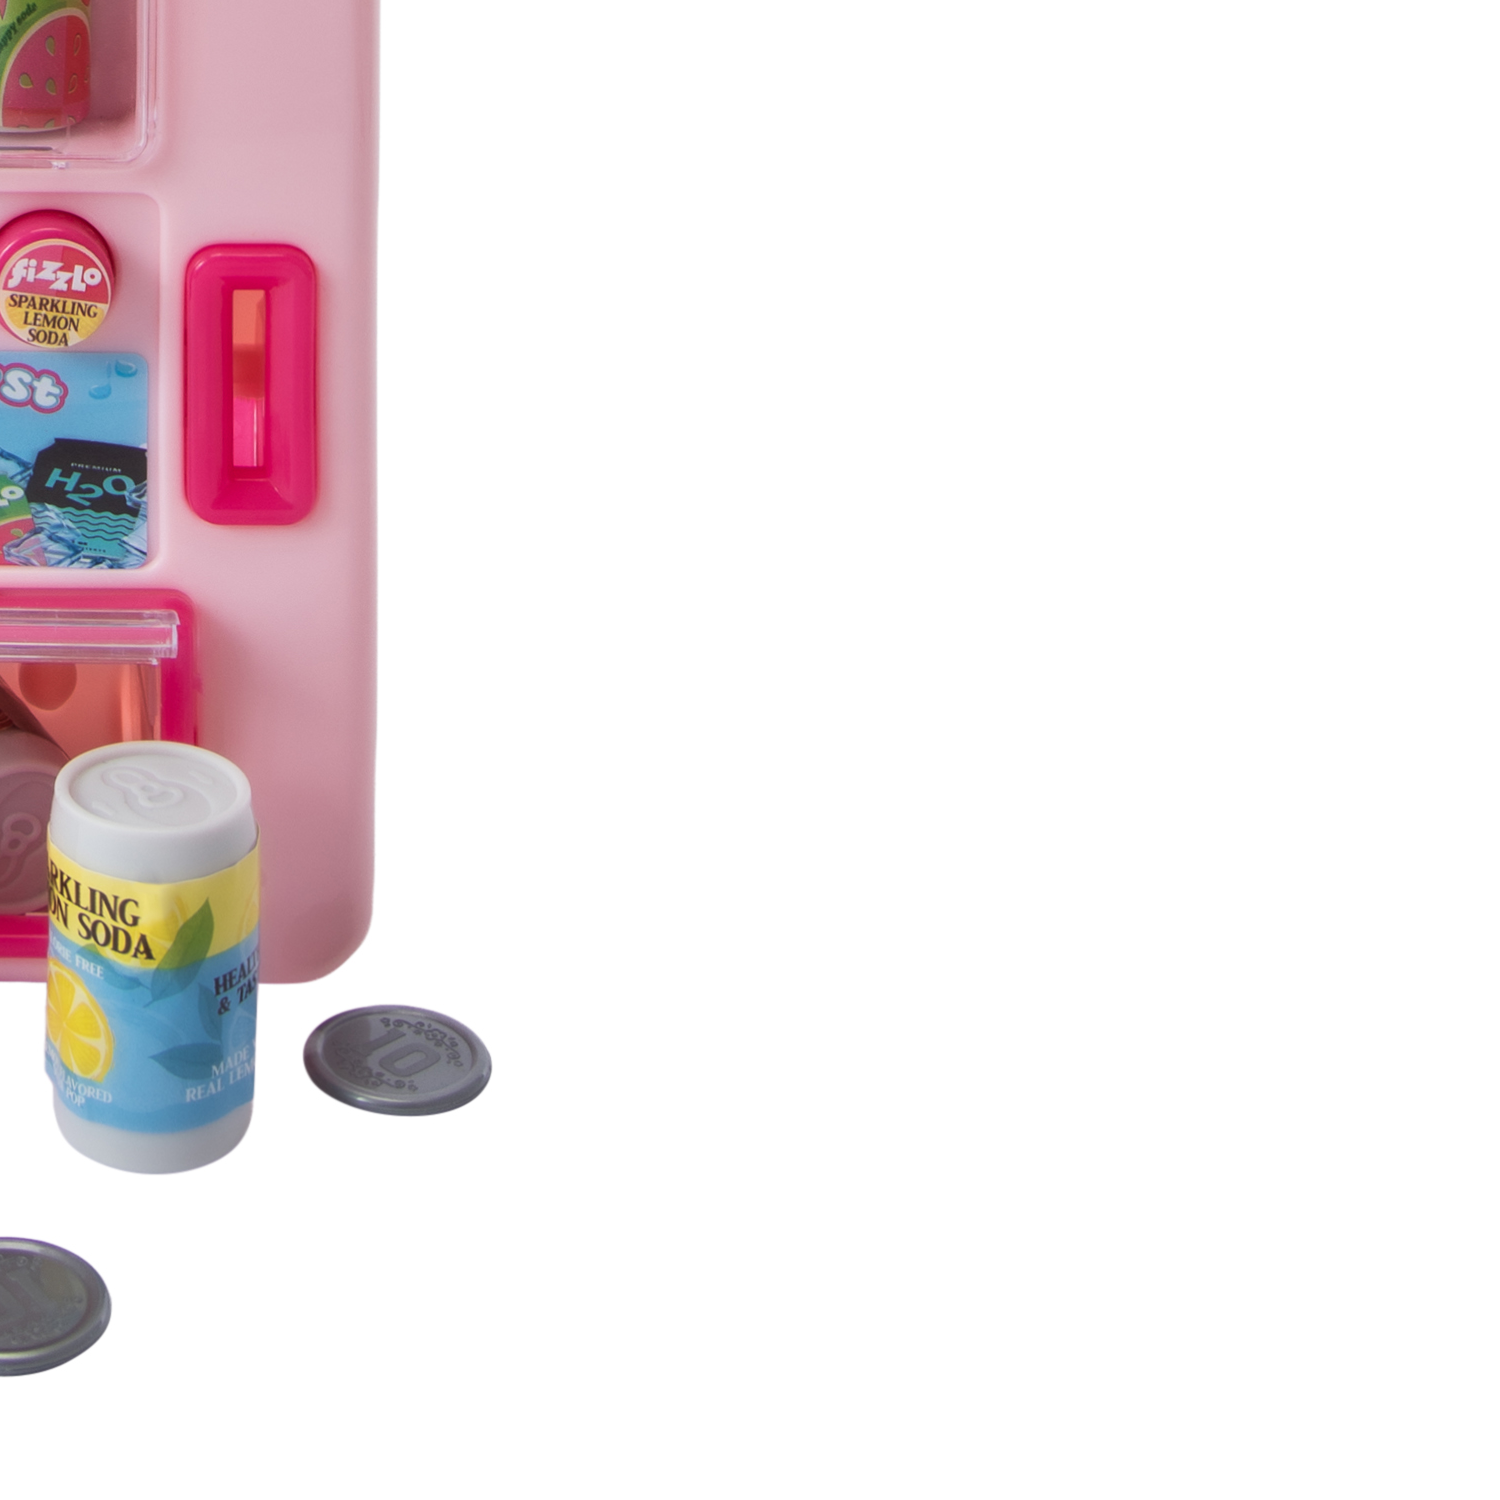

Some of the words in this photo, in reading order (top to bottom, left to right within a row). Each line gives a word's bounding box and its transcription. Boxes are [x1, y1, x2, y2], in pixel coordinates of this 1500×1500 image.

[16, 2, 38, 26] soda
[7, 257, 102, 292] fizzlo
[8, 293, 98, 318] SPARKLING
[23, 311, 80, 332] LEMON
[27, 328, 69, 347] SODA
[70, 462, 122, 473] PREMIUM
[49, 858, 141, 927] RKLING
[77, 912, 156, 961] SODA
[51, 936, 73, 963] ORIE
[75, 954, 104, 980] FREE
[214, 951, 259, 997] HEALT
[218, 996, 232, 1016] &
[211, 1044, 251, 1079] MADE
[351, 1027, 442, 1078] 10
[62, 1071, 113, 1104] AVORED
[66, 1086, 86, 1107] POP
[186, 1078, 226, 1103] REAL
